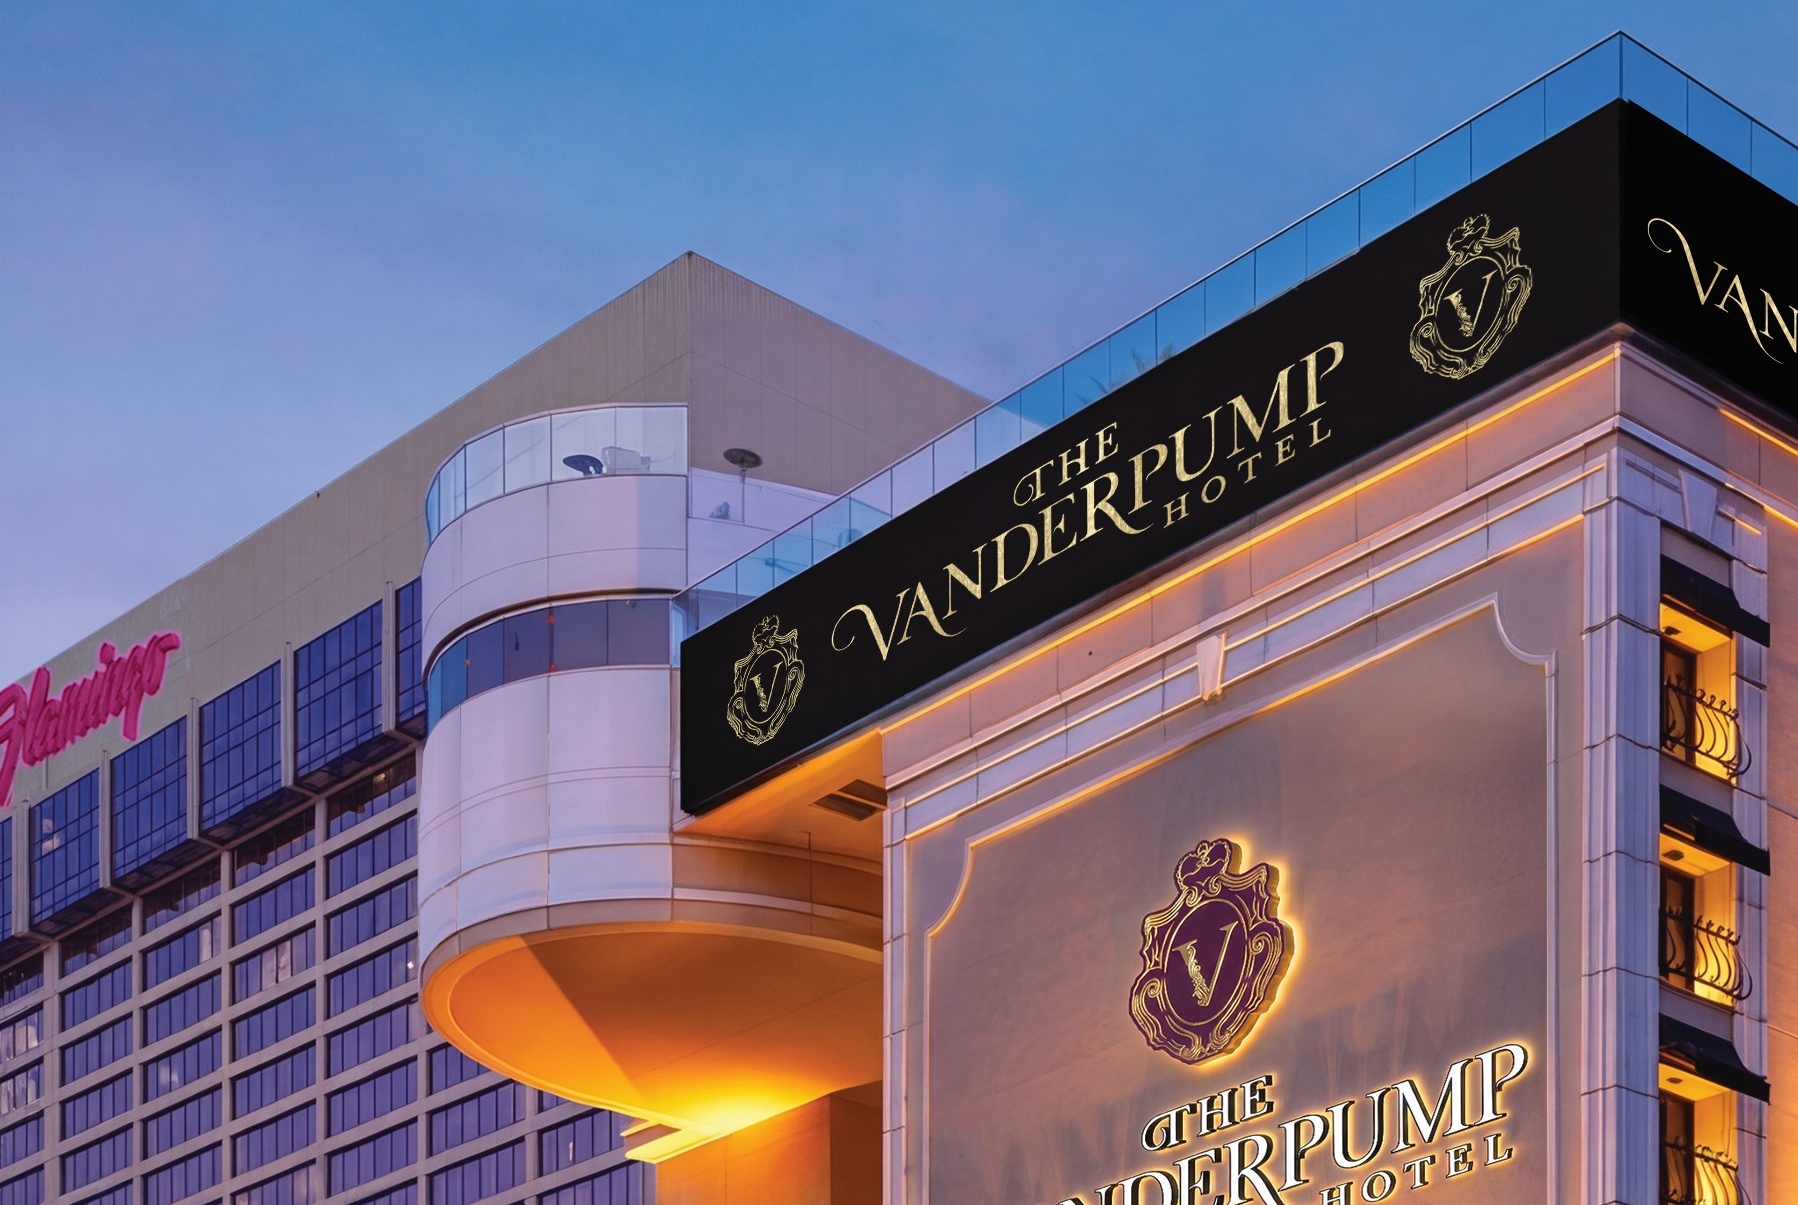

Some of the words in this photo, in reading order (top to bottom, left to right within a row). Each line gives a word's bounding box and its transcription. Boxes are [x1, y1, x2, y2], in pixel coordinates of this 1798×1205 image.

[831, 341, 1345, 662] VANDERPUMP
[1013, 421, 1119, 507] THE
[1163, 417, 1332, 529] HOTEL
[1172, 920, 1240, 1007] V
[1141, 1074, 1276, 1152] THE
